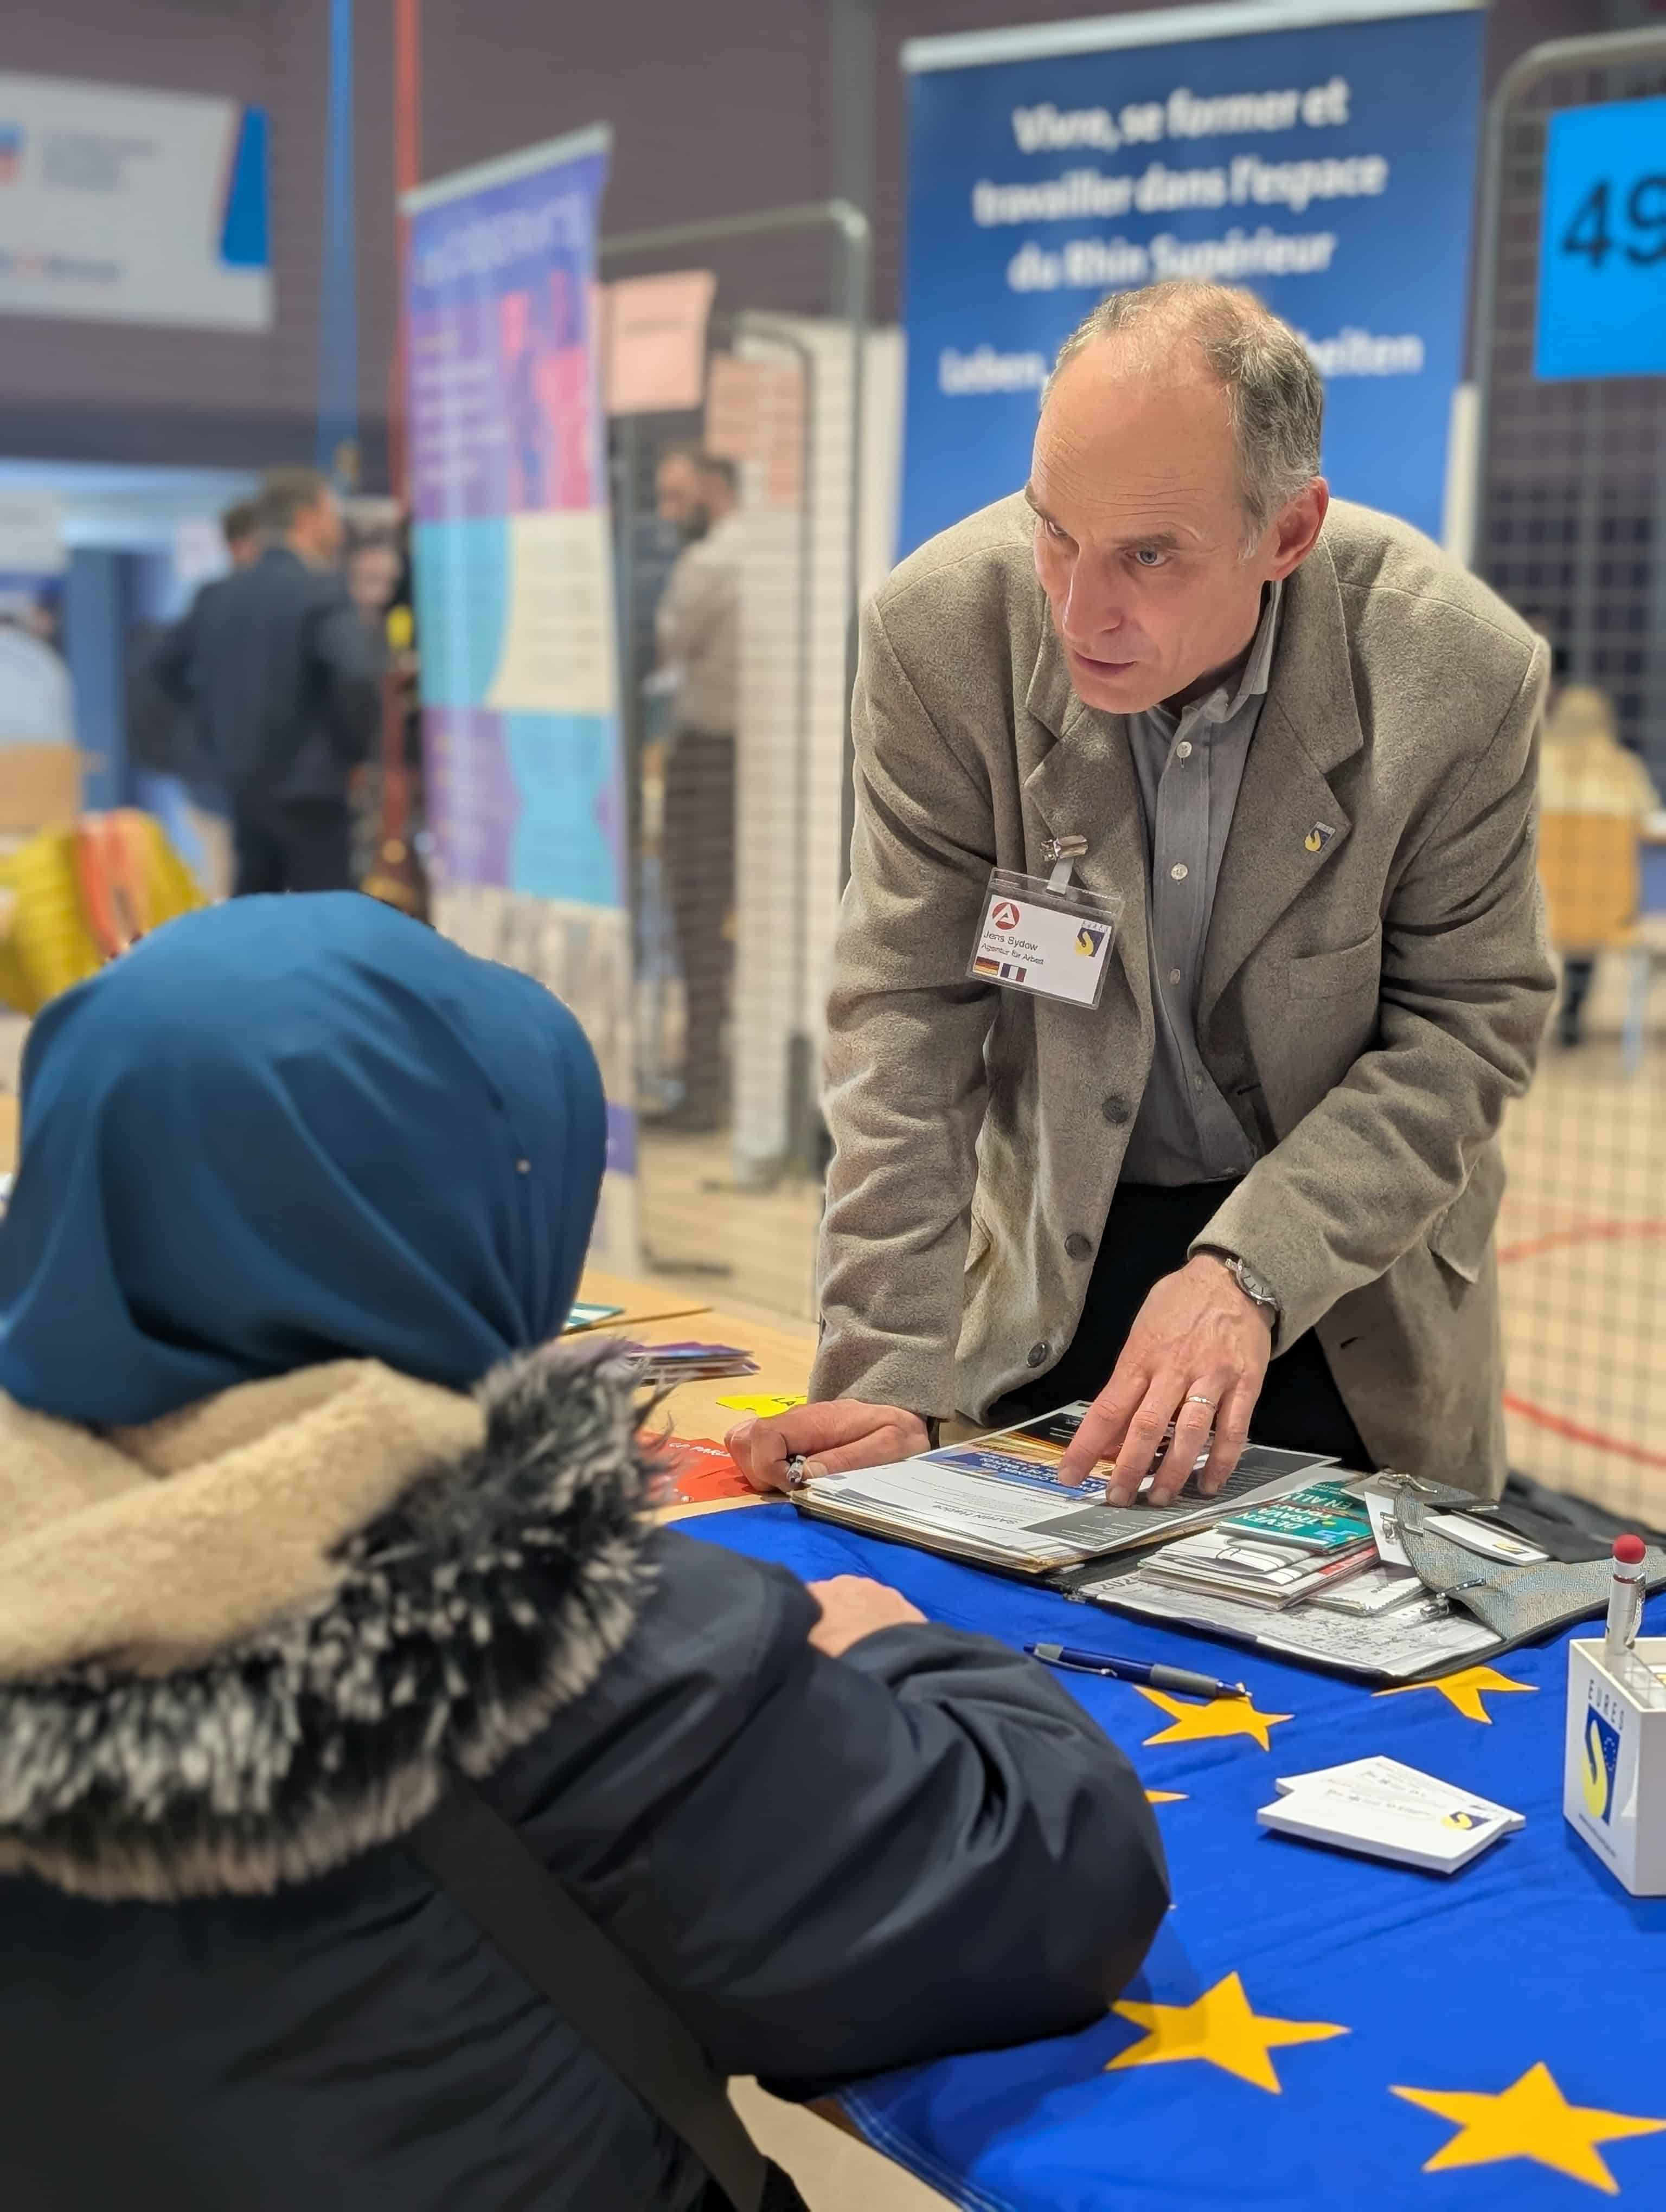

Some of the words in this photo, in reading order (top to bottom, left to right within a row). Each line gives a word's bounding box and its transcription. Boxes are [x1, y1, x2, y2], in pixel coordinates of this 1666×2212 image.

[1012, 103, 1120, 154] Vivre,
[1120, 101, 1163, 144] se
[1166, 86, 1300, 140] former
[1302, 75, 1350, 126] et
[973, 168, 1135, 226] travailler
[1135, 162, 1228, 213] dans
[1229, 154, 1388, 211] l'espace
[1007, 243, 1060, 292] du
[1063, 236, 1149, 288] Rhin
[983, 930, 1005, 942] Jens
[1008, 936, 1038, 951] Sydow
[1588, 1679, 1625, 1731] EURES
